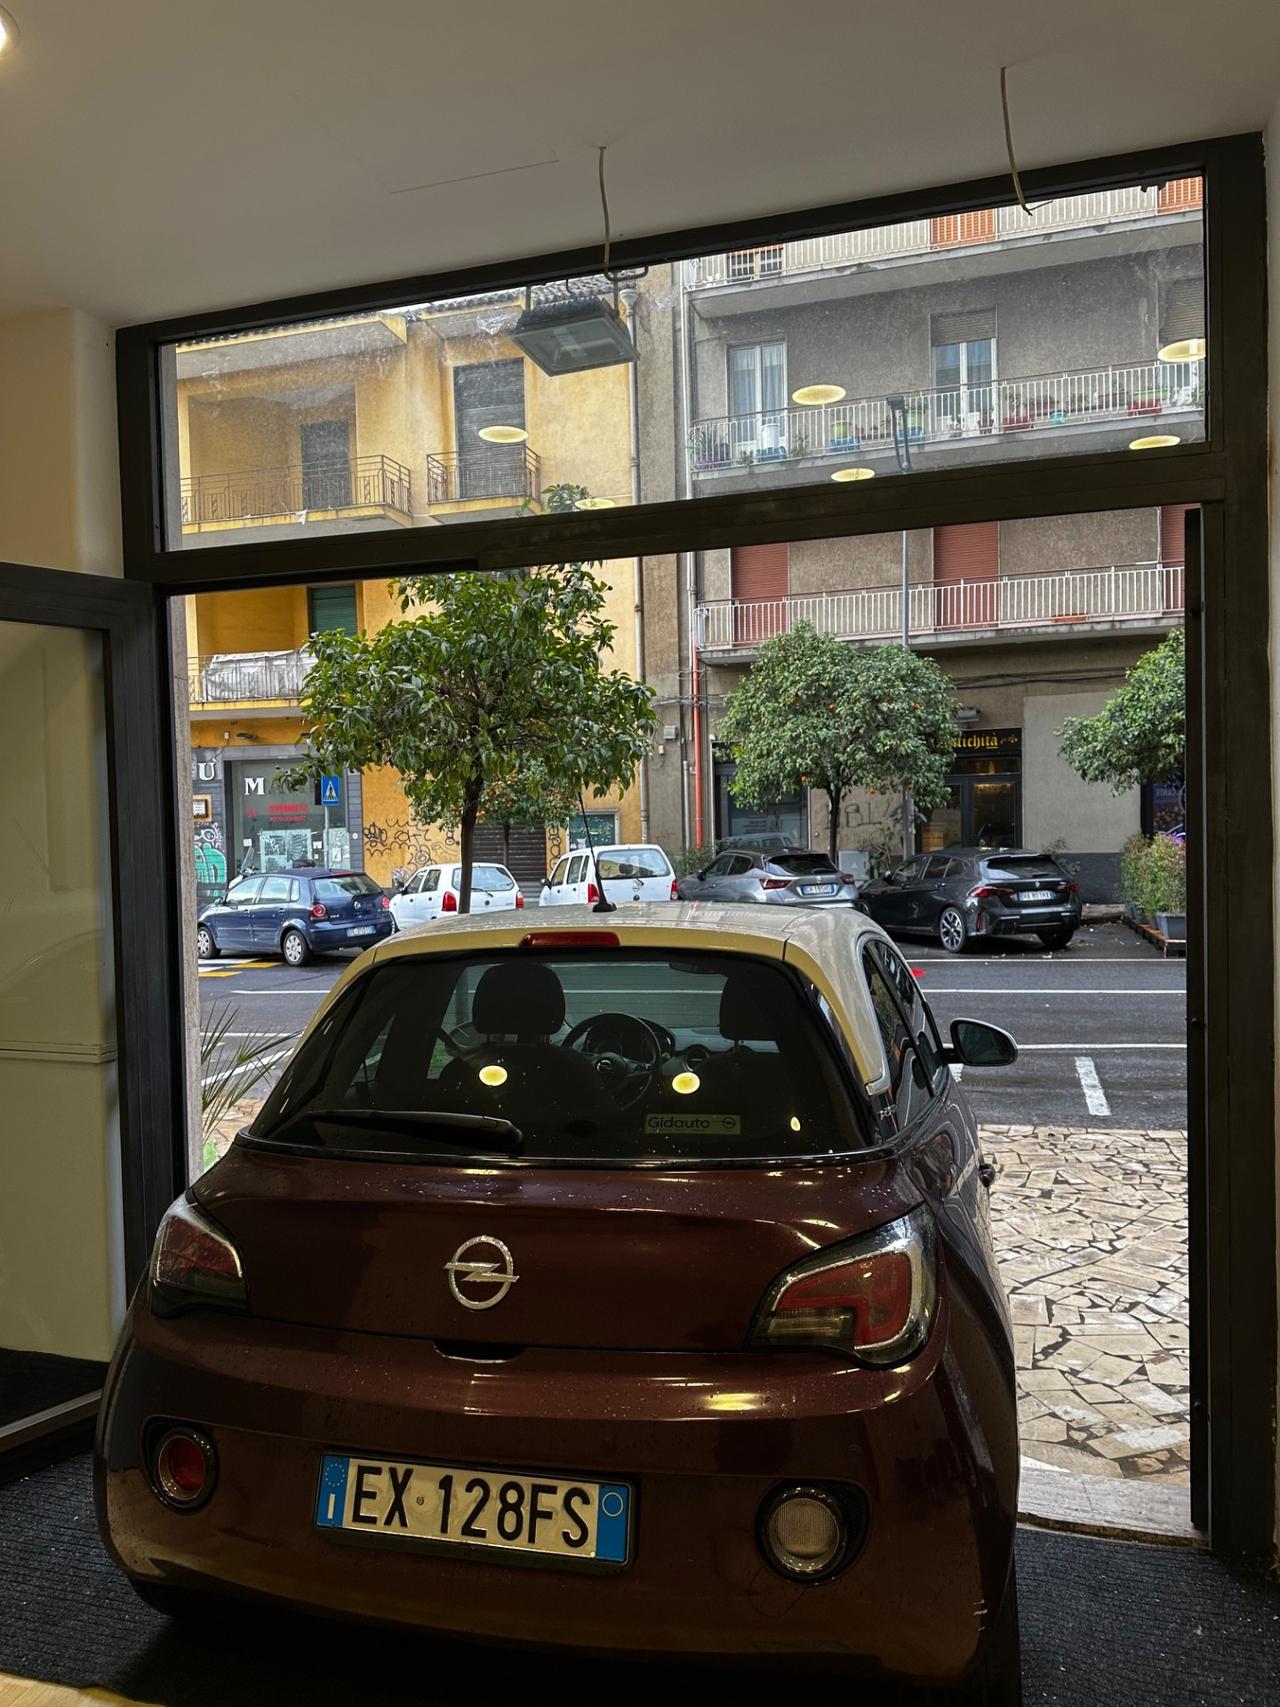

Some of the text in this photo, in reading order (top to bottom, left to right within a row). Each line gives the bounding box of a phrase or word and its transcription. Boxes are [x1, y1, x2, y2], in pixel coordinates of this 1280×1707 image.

[648, 1116, 711, 1129] Gidauto
[351, 1464, 414, 1528] EX
[438, 1474, 591, 1548] 128FS
